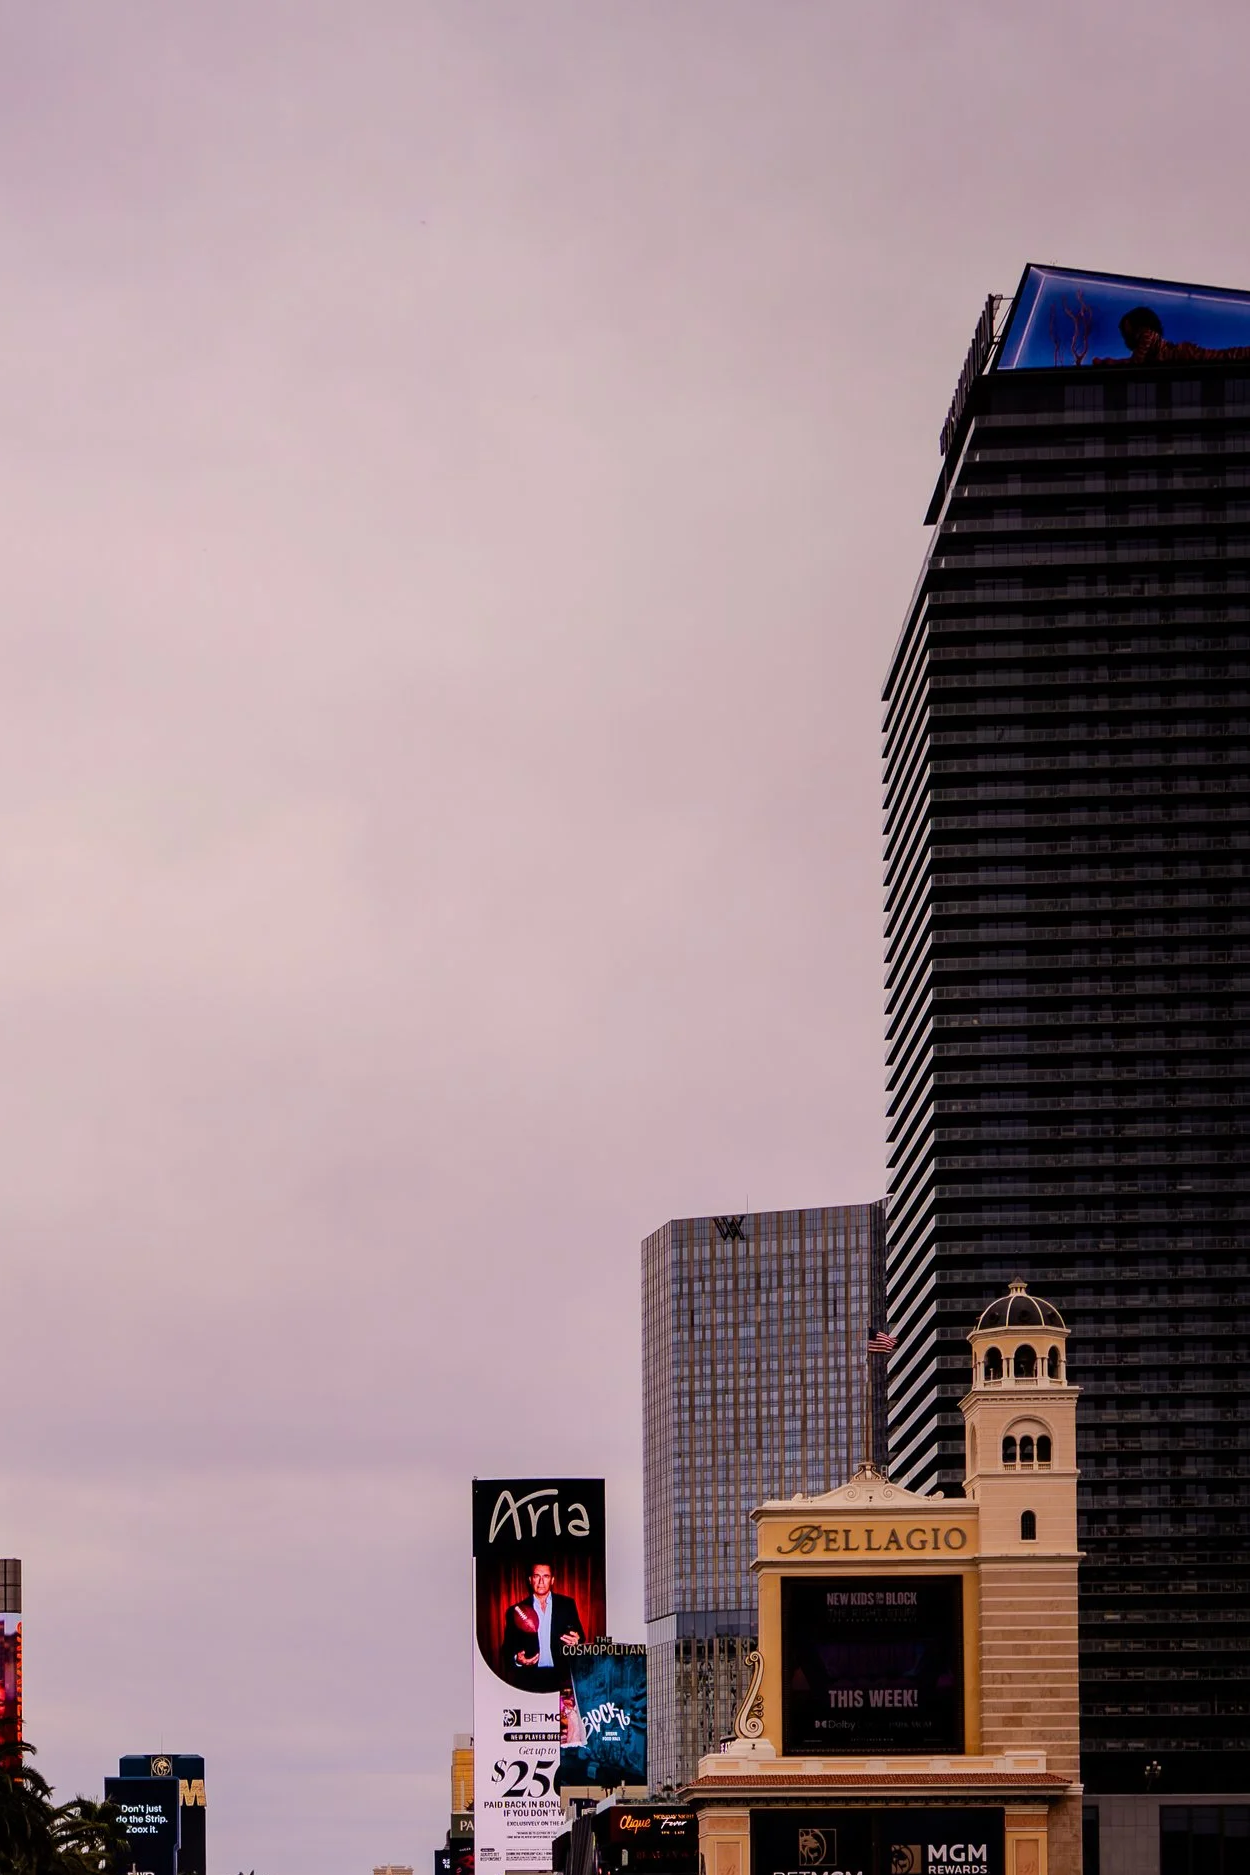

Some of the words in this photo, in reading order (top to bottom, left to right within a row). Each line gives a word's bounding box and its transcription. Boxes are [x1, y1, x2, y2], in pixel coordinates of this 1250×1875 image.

[488, 1489, 590, 1543] Aria
[777, 1525, 967, 1554] BELLAGIO
[826, 1592, 849, 1606] NEW
[850, 1592, 874, 1606] KIDS
[886, 1592, 918, 1606] BLOCK
[596, 1636, 612, 1644] THE
[562, 1644, 645, 1656] COSMOPOLITAN
[828, 1690, 864, 1709] THIS
[868, 1689, 919, 1708] WEEK!
[828, 1719, 856, 1731] Dolby
[519, 1746, 533, 1755] Get
[535, 1747, 547, 1757] up
[549, 1747, 557, 1755] to
[121, 1804, 145, 1813] Don't
[146, 1804, 162, 1814] just
[116, 1814, 127, 1823] do
[129, 1814, 144, 1823] the
[145, 1815, 168, 1825] Strip.
[620, 1814, 651, 1835] Clique
[126, 1826, 148, 1834] Zoox
[150, 1826, 159, 1834] it.
[927, 1843, 988, 1862] MGM
[928, 1864, 988, 1875] REWARDS
